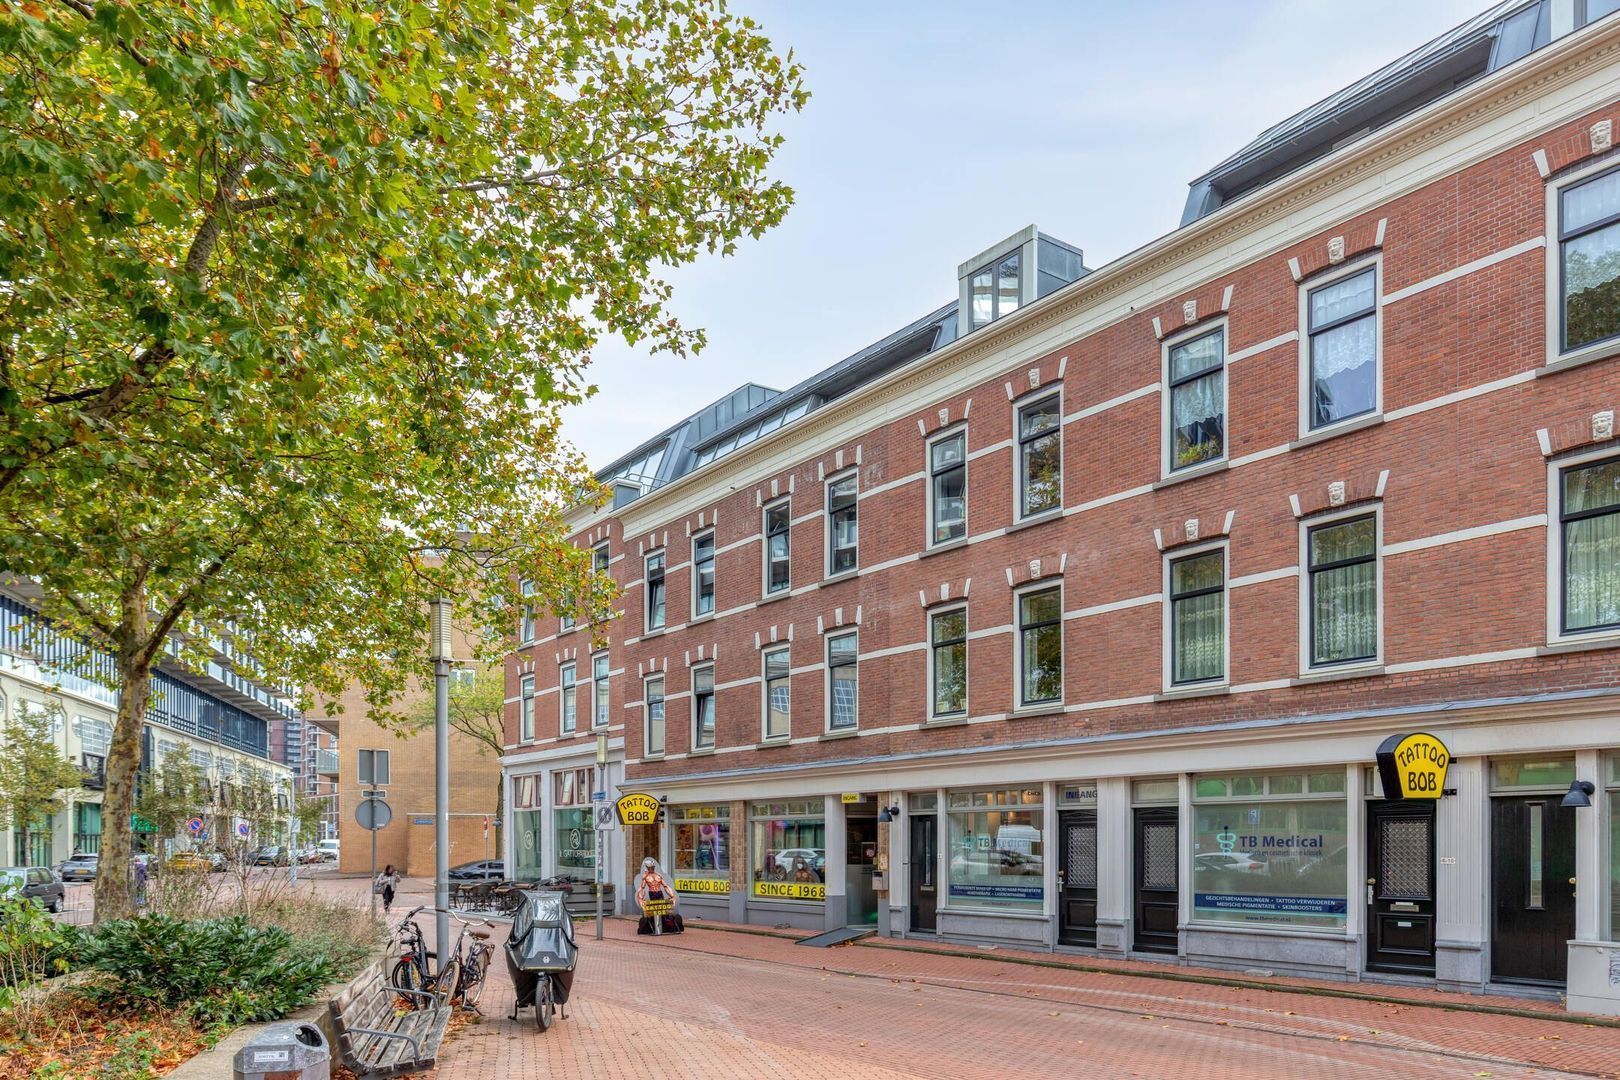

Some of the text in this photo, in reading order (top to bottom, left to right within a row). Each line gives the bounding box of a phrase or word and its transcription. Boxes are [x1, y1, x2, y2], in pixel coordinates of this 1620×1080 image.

[1398, 743, 1446, 769] TATTOO
[1408, 771, 1437, 791] BOB
[620, 797, 657, 810] TATTOO
[628, 811, 649, 821] BOB
[978, 838, 990, 847] TB
[1240, 834, 1323, 848] TB Medical
[678, 879, 731, 892] TATTOO BOB
[760, 883, 826, 898] SINCE 1968
[1205, 895, 1269, 903] GEZICHTSBEHANDELINGEN
[1296, 898, 1336, 906] VERWIJDEREN
